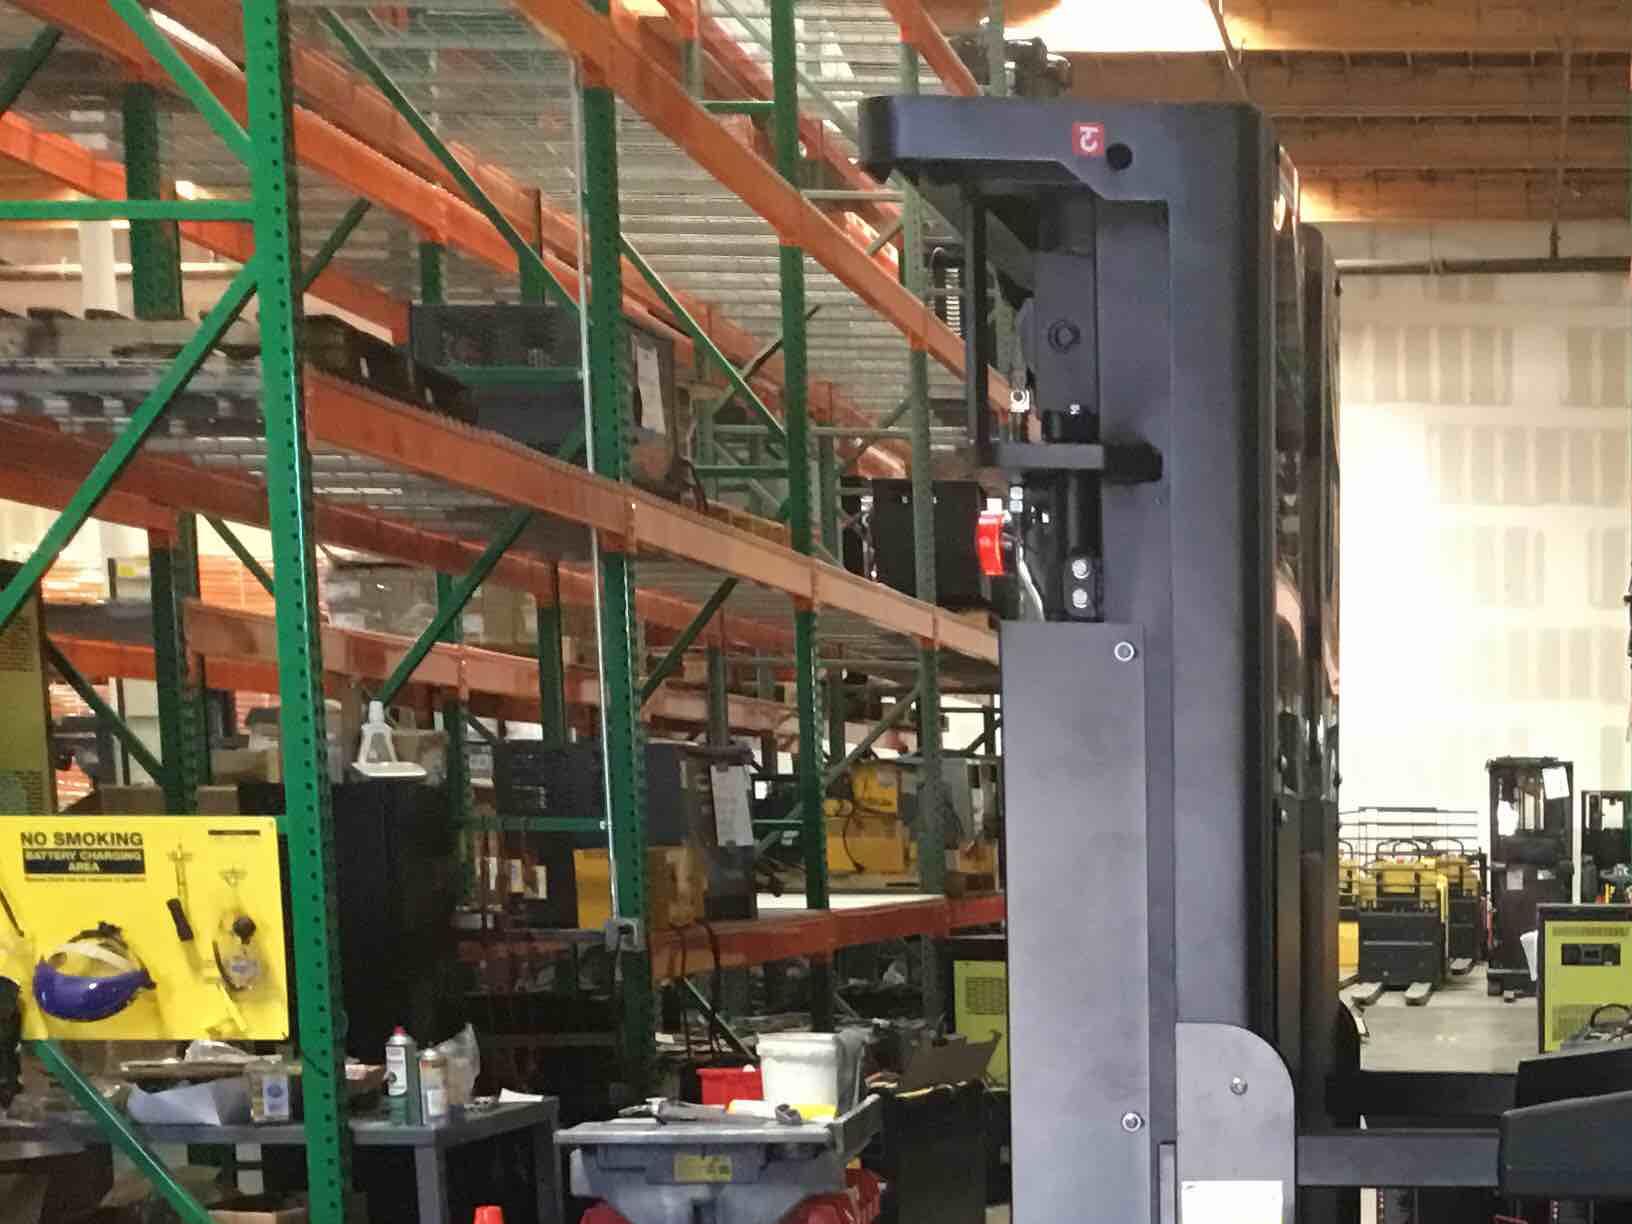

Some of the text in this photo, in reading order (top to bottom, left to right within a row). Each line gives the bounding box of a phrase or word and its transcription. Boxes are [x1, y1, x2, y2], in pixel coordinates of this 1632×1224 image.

[20, 832, 143, 846] NO SMOKING
[68, 862, 100, 873] AREA
